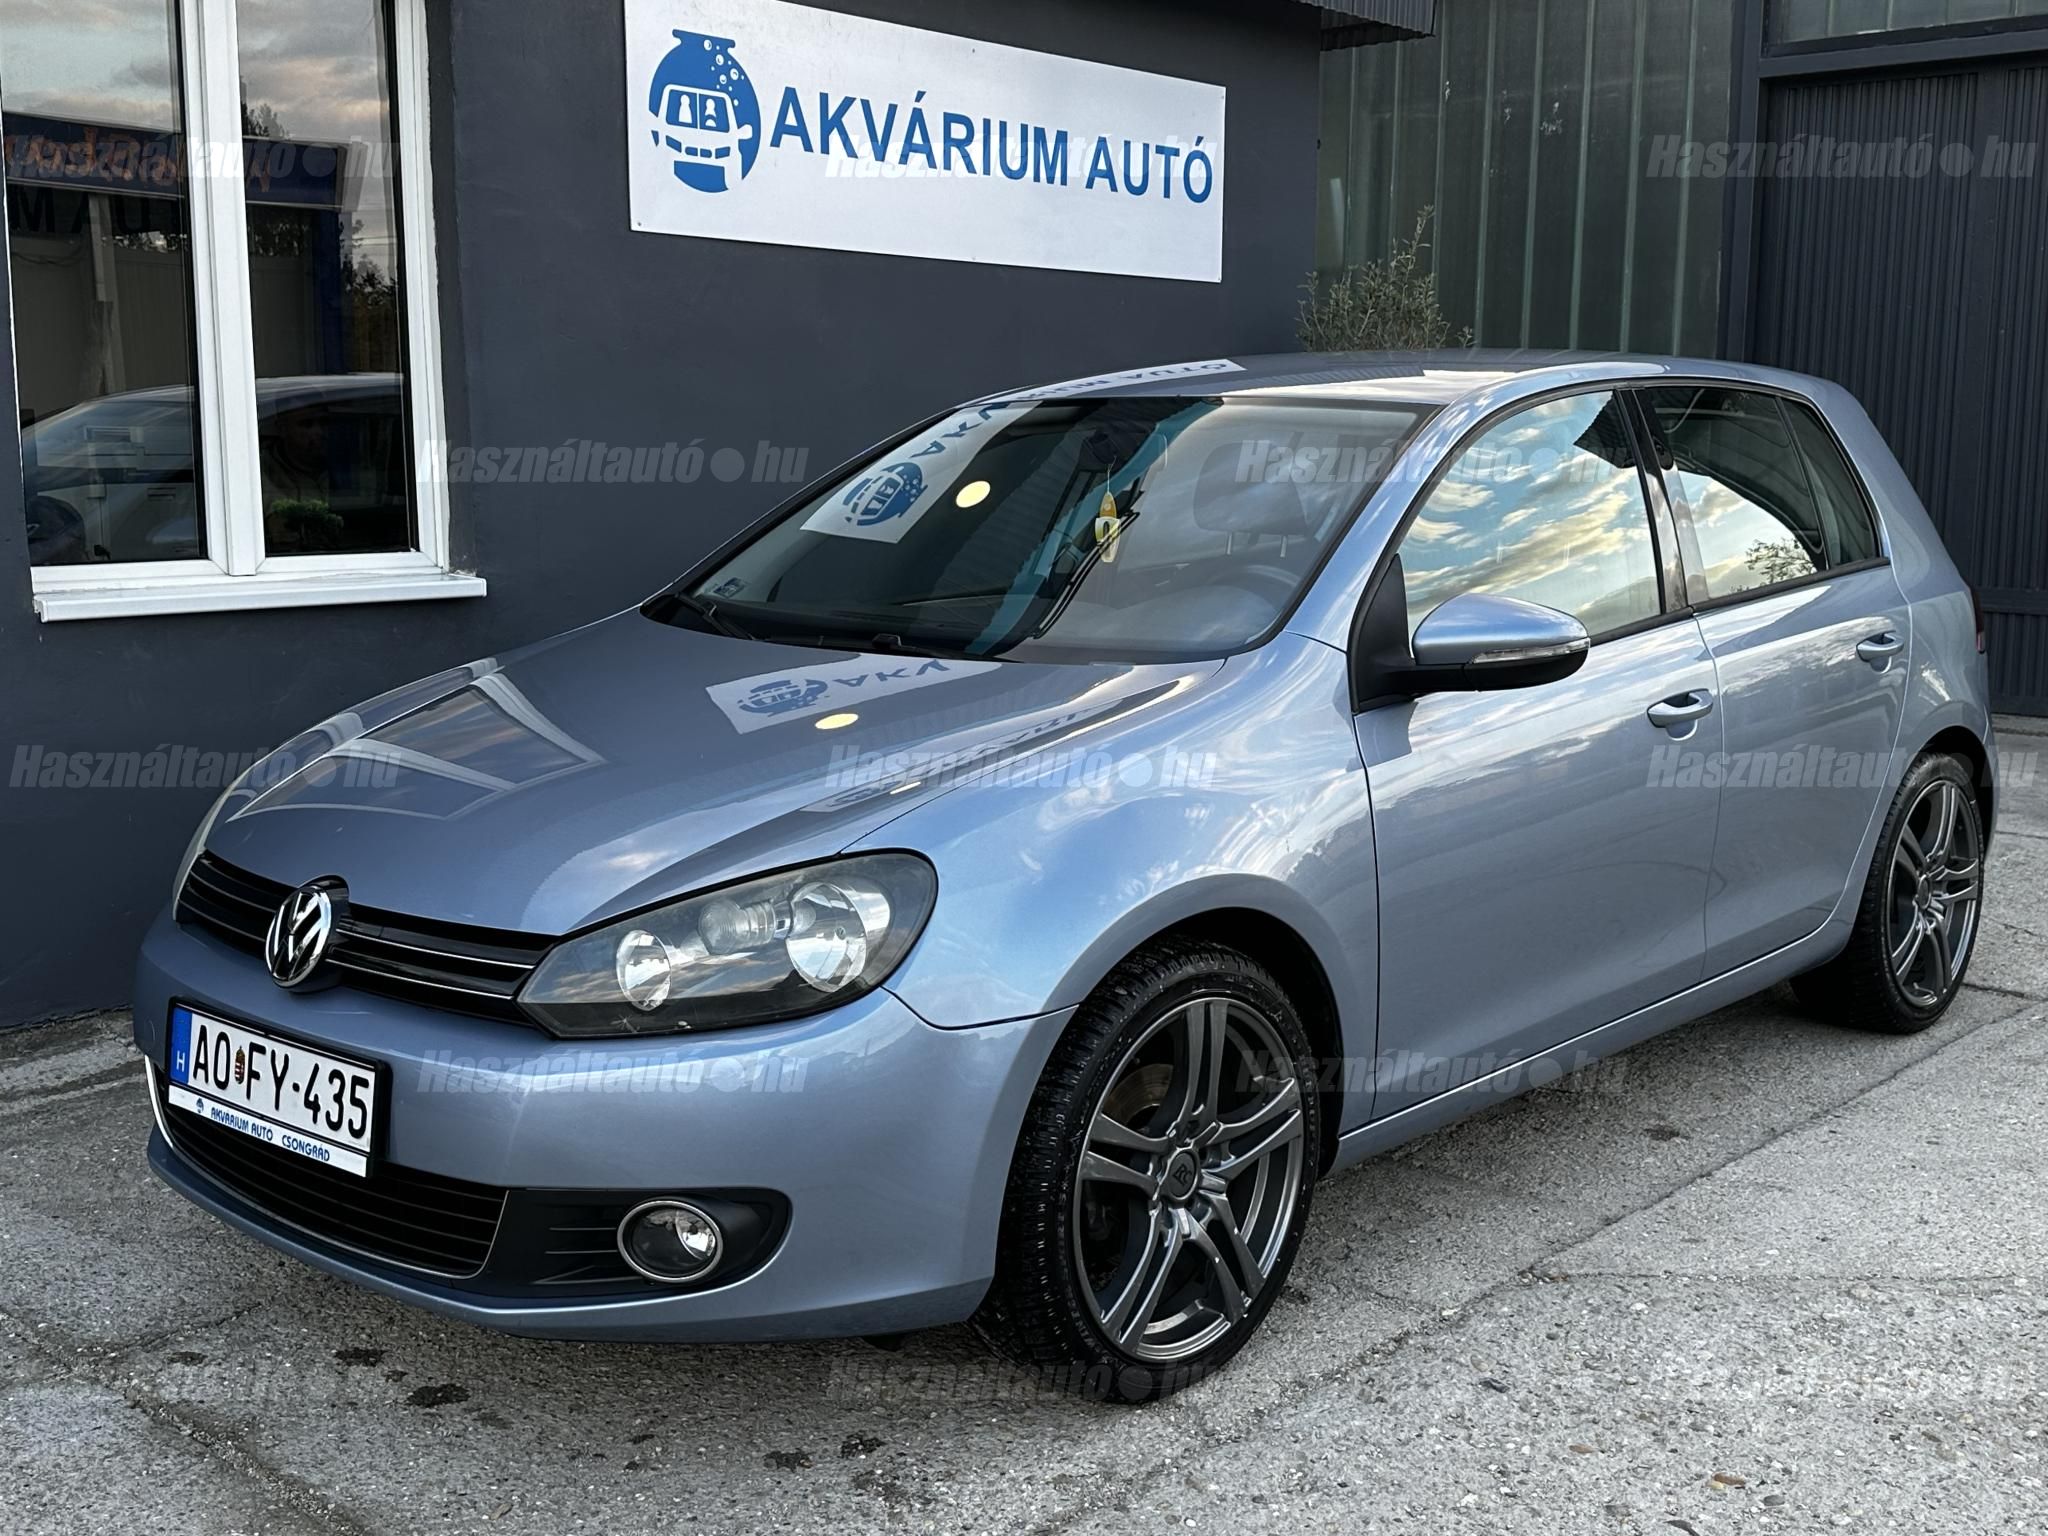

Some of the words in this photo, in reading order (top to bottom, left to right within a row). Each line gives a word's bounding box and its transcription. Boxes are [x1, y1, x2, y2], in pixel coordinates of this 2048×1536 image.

[769, 86, 1068, 187] AKVÁRIUM
[1085, 136, 1213, 204] AUTÓ
[176, 1051, 185, 1072] H
[282, 1134, 330, 1162] CSONGRÁD
